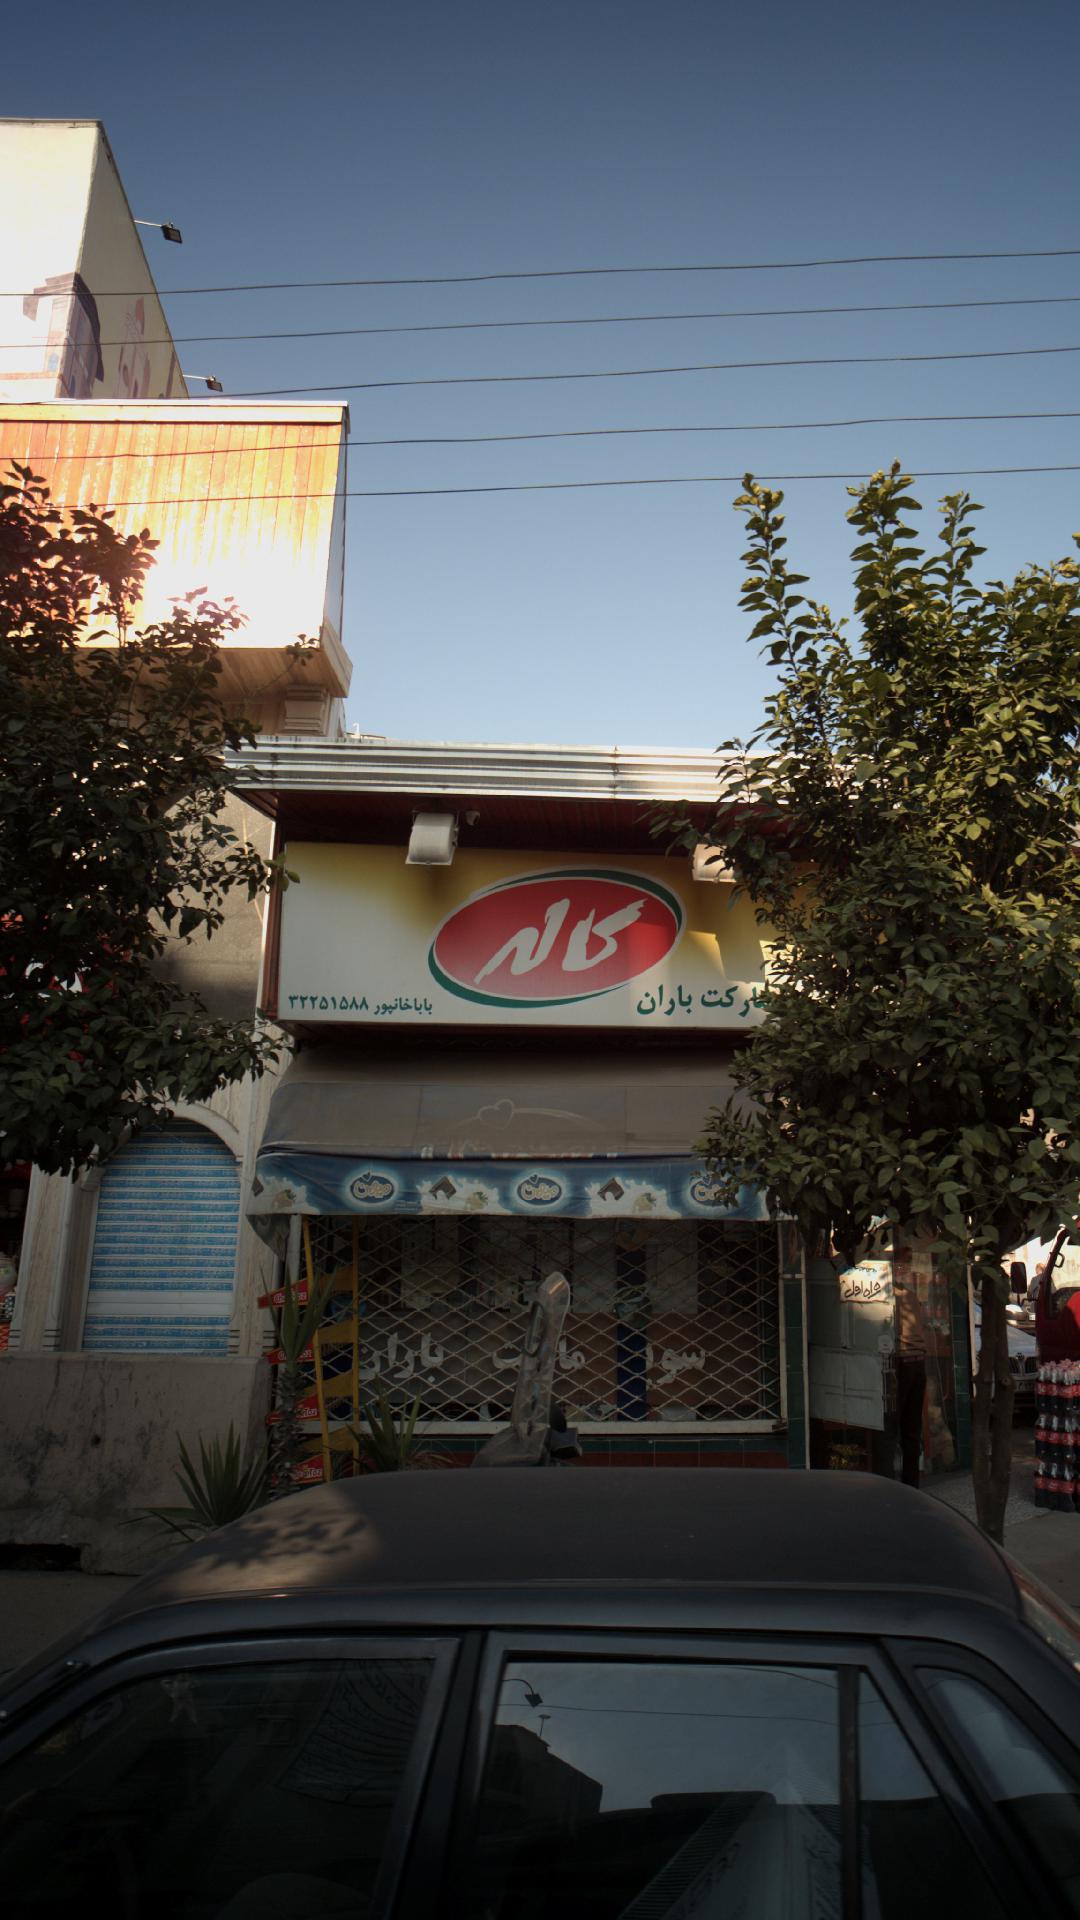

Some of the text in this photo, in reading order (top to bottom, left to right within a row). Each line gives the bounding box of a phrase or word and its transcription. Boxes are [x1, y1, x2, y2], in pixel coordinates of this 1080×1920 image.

[473, 898, 649, 985] کاله
[374, 997, 433, 1015] باباخانپور
[636, 983, 693, 1016] باران
